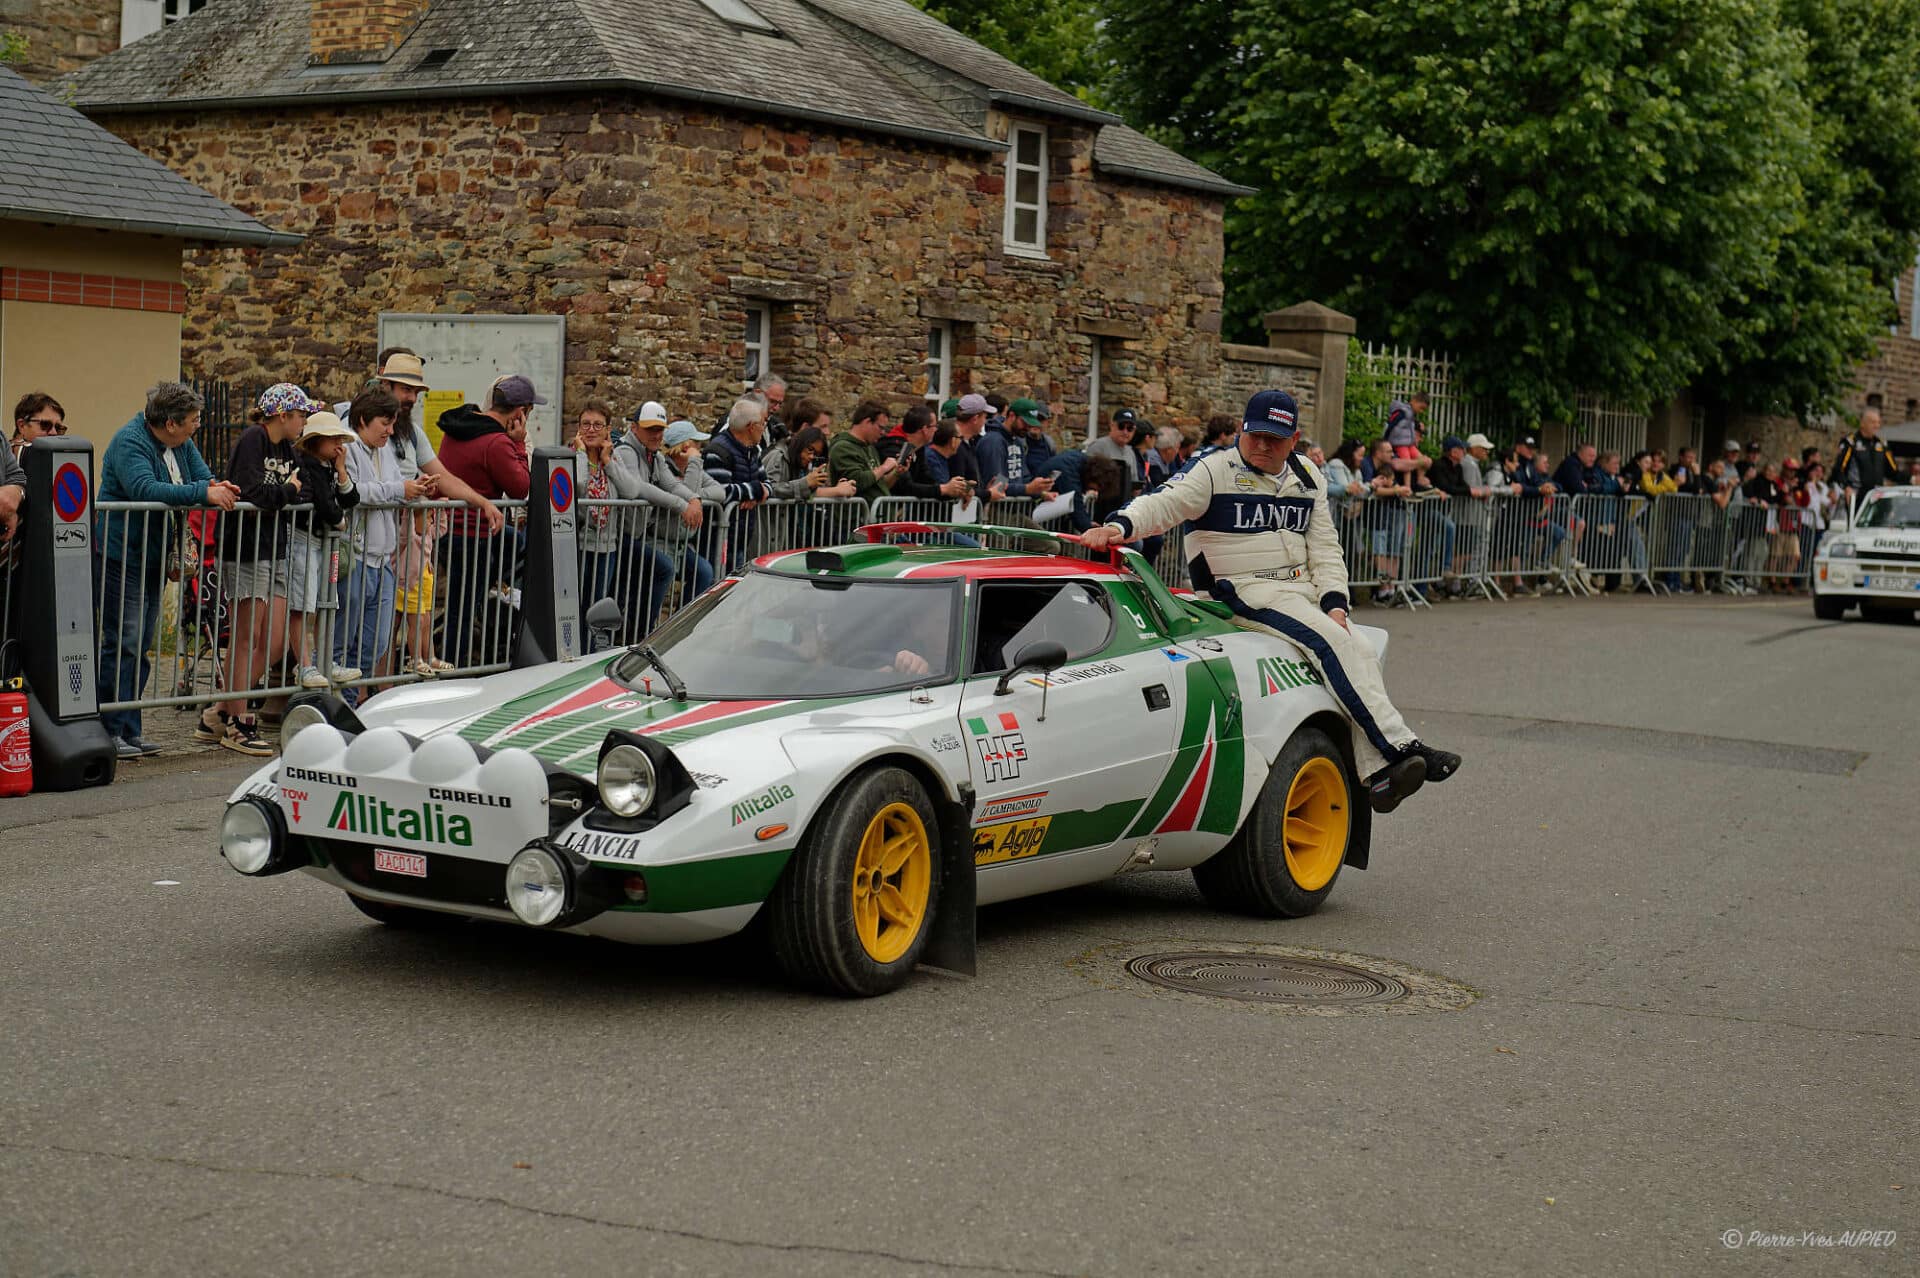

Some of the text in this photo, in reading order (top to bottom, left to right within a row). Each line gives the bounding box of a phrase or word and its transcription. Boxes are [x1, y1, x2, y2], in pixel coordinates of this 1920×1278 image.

[976, 733, 1028, 783] HF
[286, 766, 357, 788] CARELLO
[281, 788, 308, 801] TOW
[429, 788, 511, 808] CARELLO
[732, 785, 794, 827] Alitalia
[989, 799, 1042, 816] CAMPAGNOLO
[327, 790, 472, 847] Alitalia
[560, 832, 640, 860] LANCIA
[998, 821, 1046, 856] Agip
